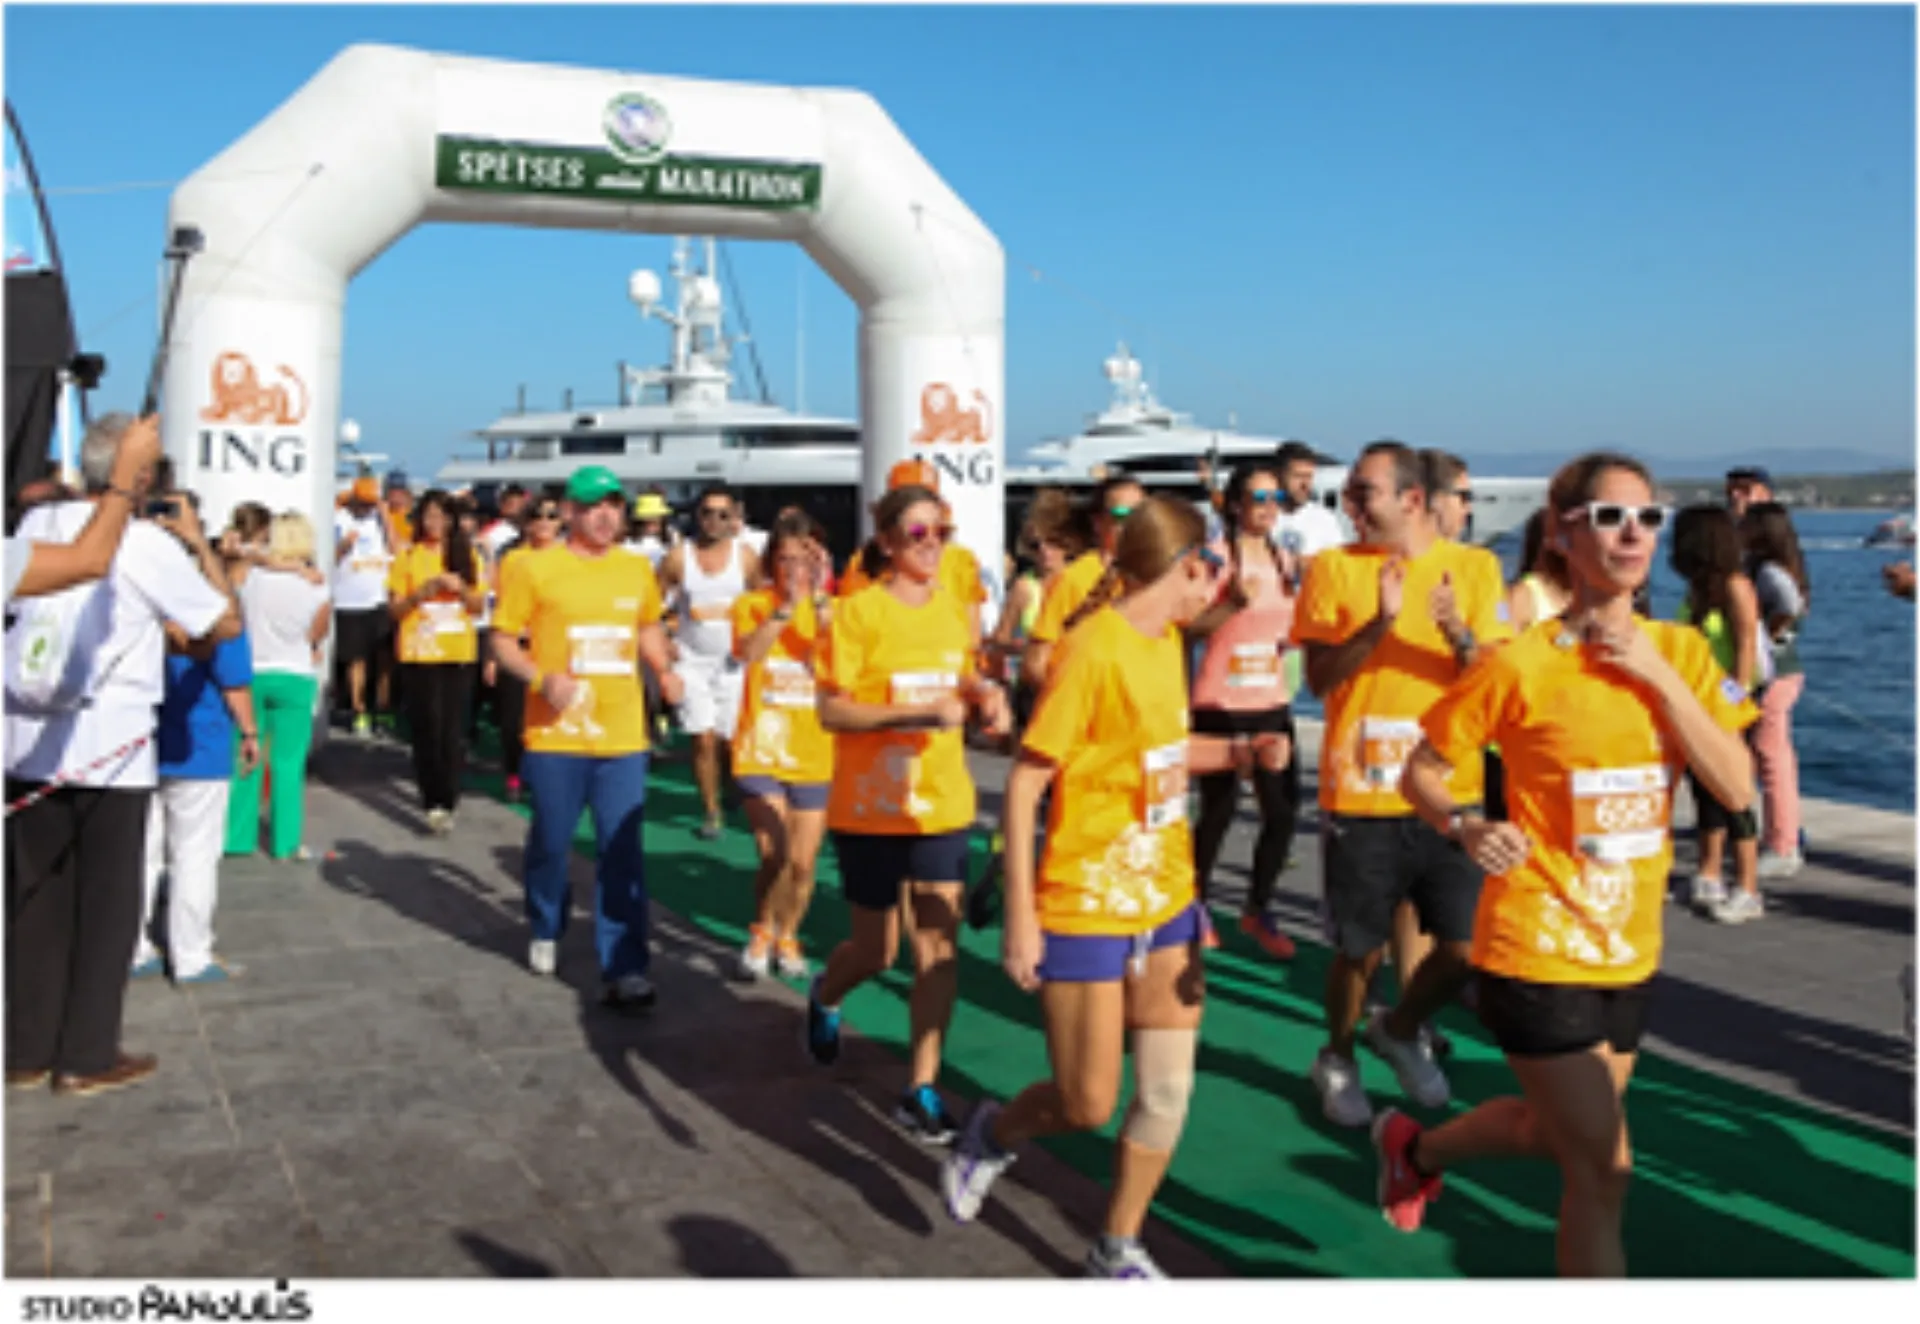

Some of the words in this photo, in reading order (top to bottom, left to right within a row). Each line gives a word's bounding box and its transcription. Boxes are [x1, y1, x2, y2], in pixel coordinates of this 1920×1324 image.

[457, 149, 585, 188] SPETSES
[658, 166, 804, 200] MARATHON
[199, 429, 305, 477] ING
[914, 451, 993, 486] NG
